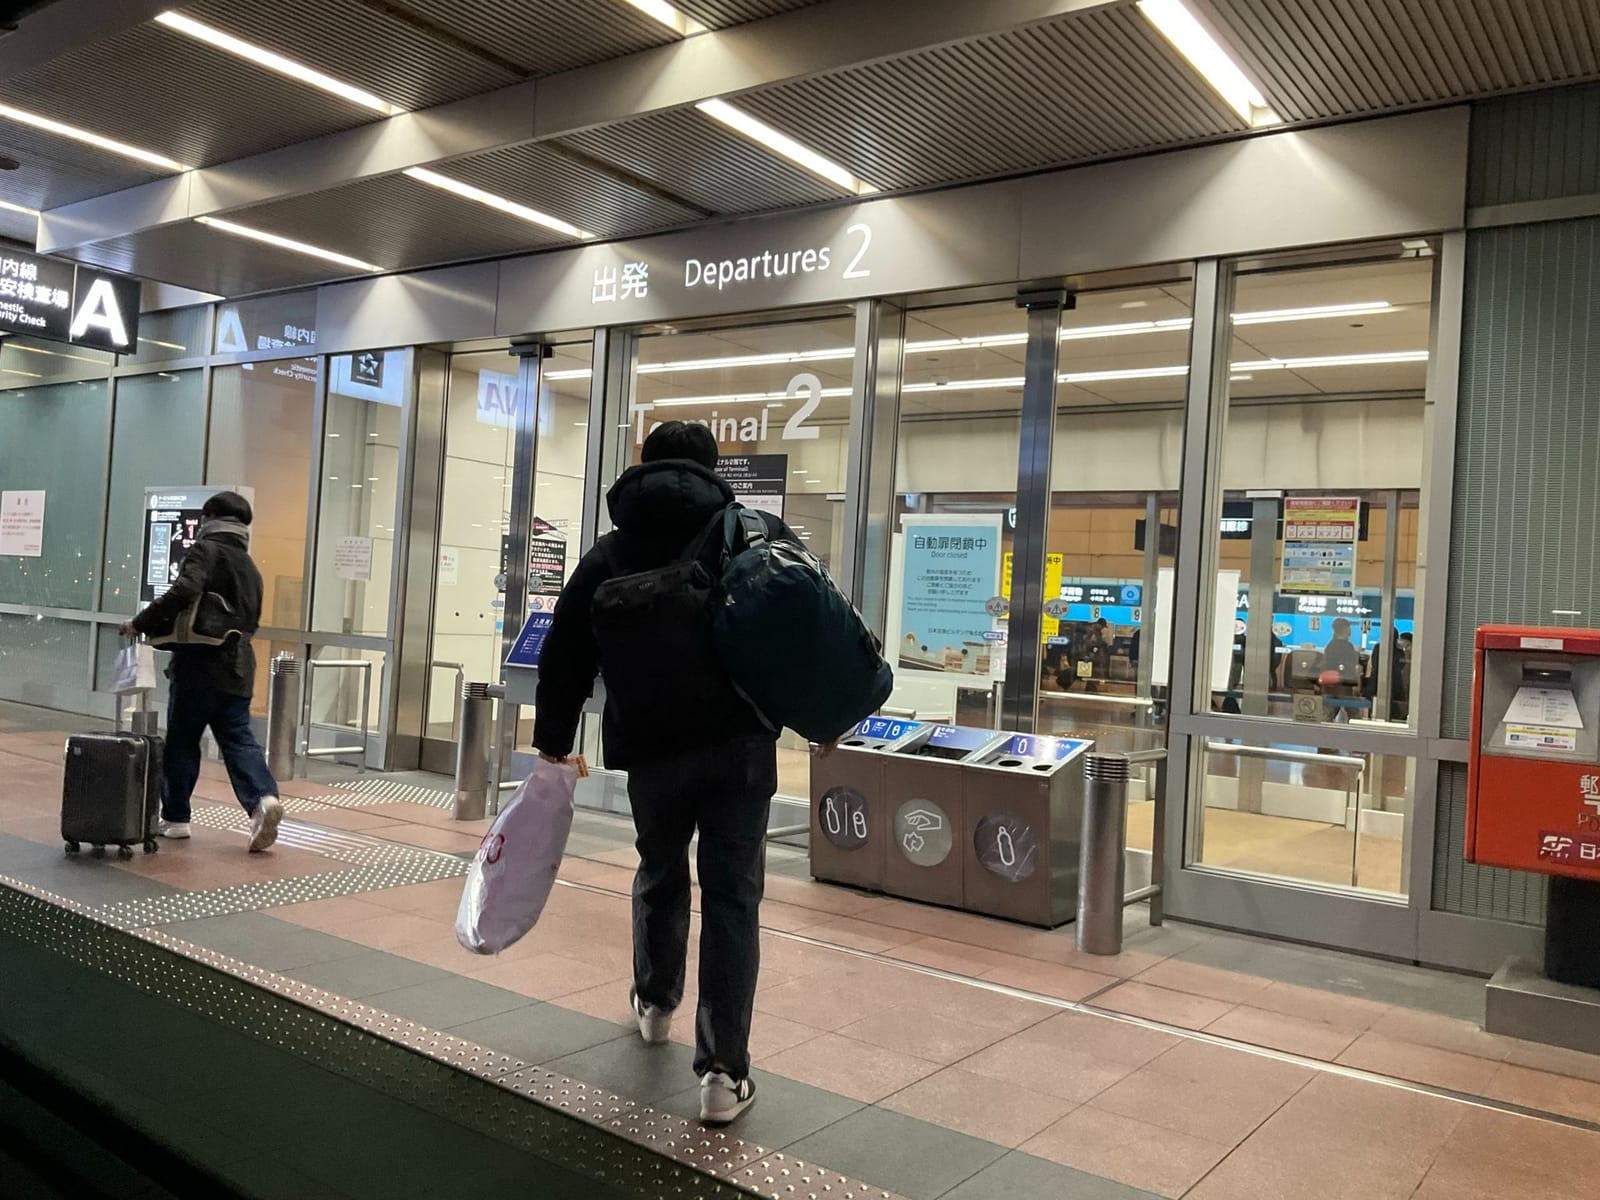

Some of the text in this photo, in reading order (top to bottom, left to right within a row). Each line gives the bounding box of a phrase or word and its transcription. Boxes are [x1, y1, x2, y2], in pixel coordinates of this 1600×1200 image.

[0, 256, 37, 281] 内線
[684, 223, 872, 291] Departures 2
[592, 260, 649, 304] 出発
[70, 278, 129, 346] A
[782, 373, 822, 440] 2
[914, 535, 987, 551] 自動扉閉鎖中
[931, 551, 946, 559] Door
[1134, 609, 1140, 621] 9
